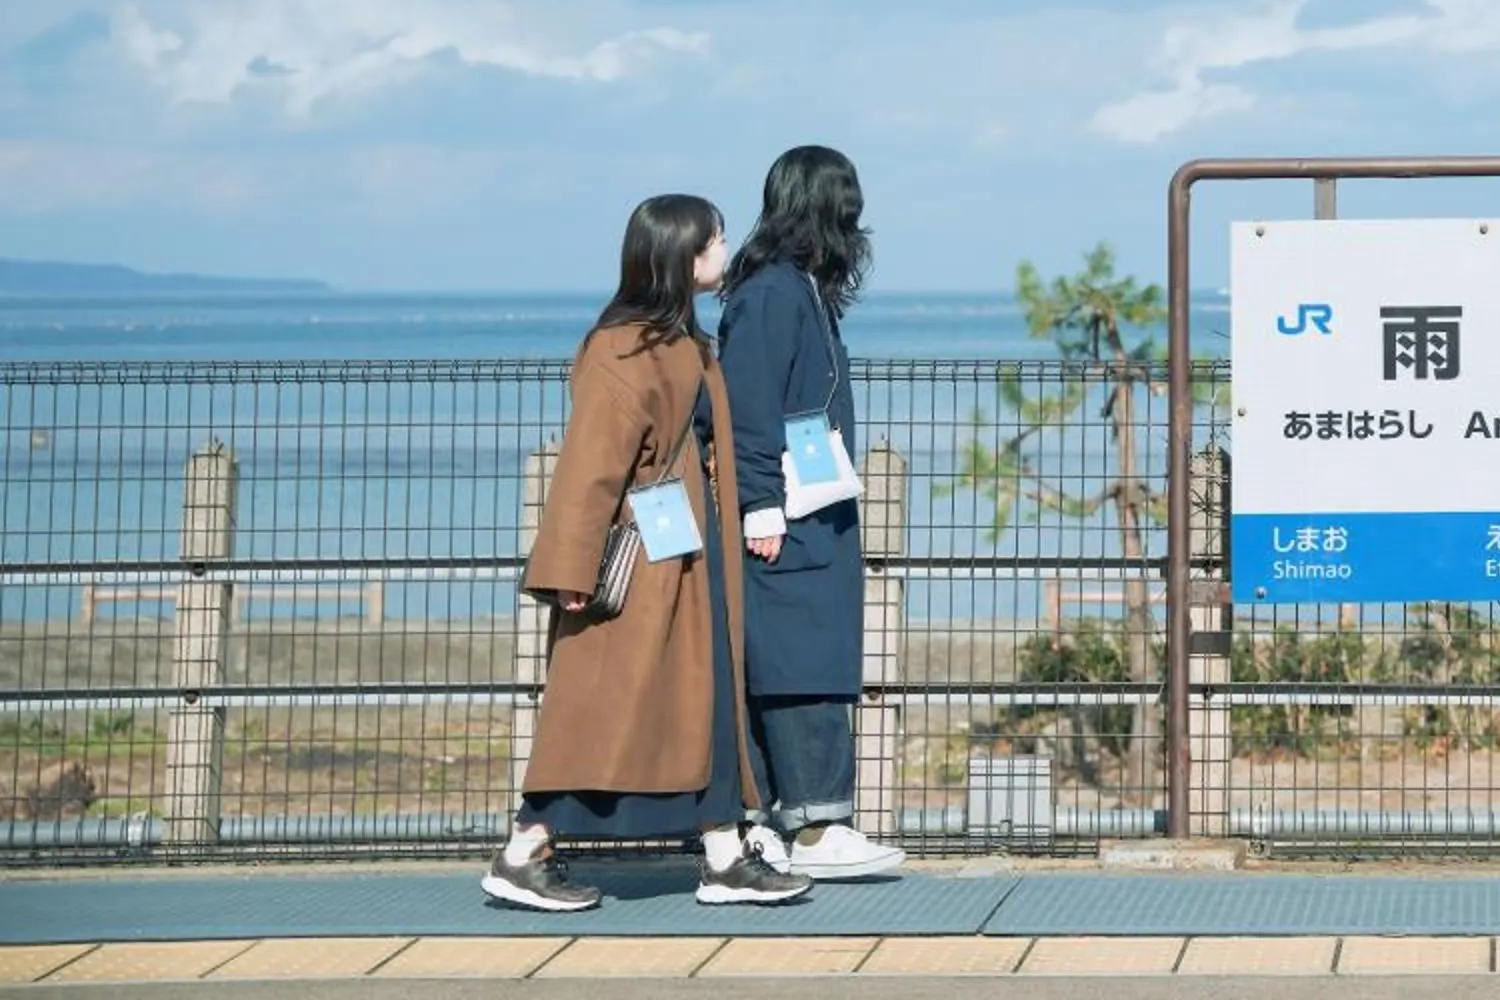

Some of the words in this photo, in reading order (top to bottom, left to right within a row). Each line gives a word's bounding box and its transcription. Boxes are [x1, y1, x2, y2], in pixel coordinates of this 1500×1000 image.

[1277, 303, 1333, 335] JR
[1283, 409, 1434, 441] あまはらし
[1273, 526, 1348, 553] しまお
[1273, 559, 1352, 579] Shimao
